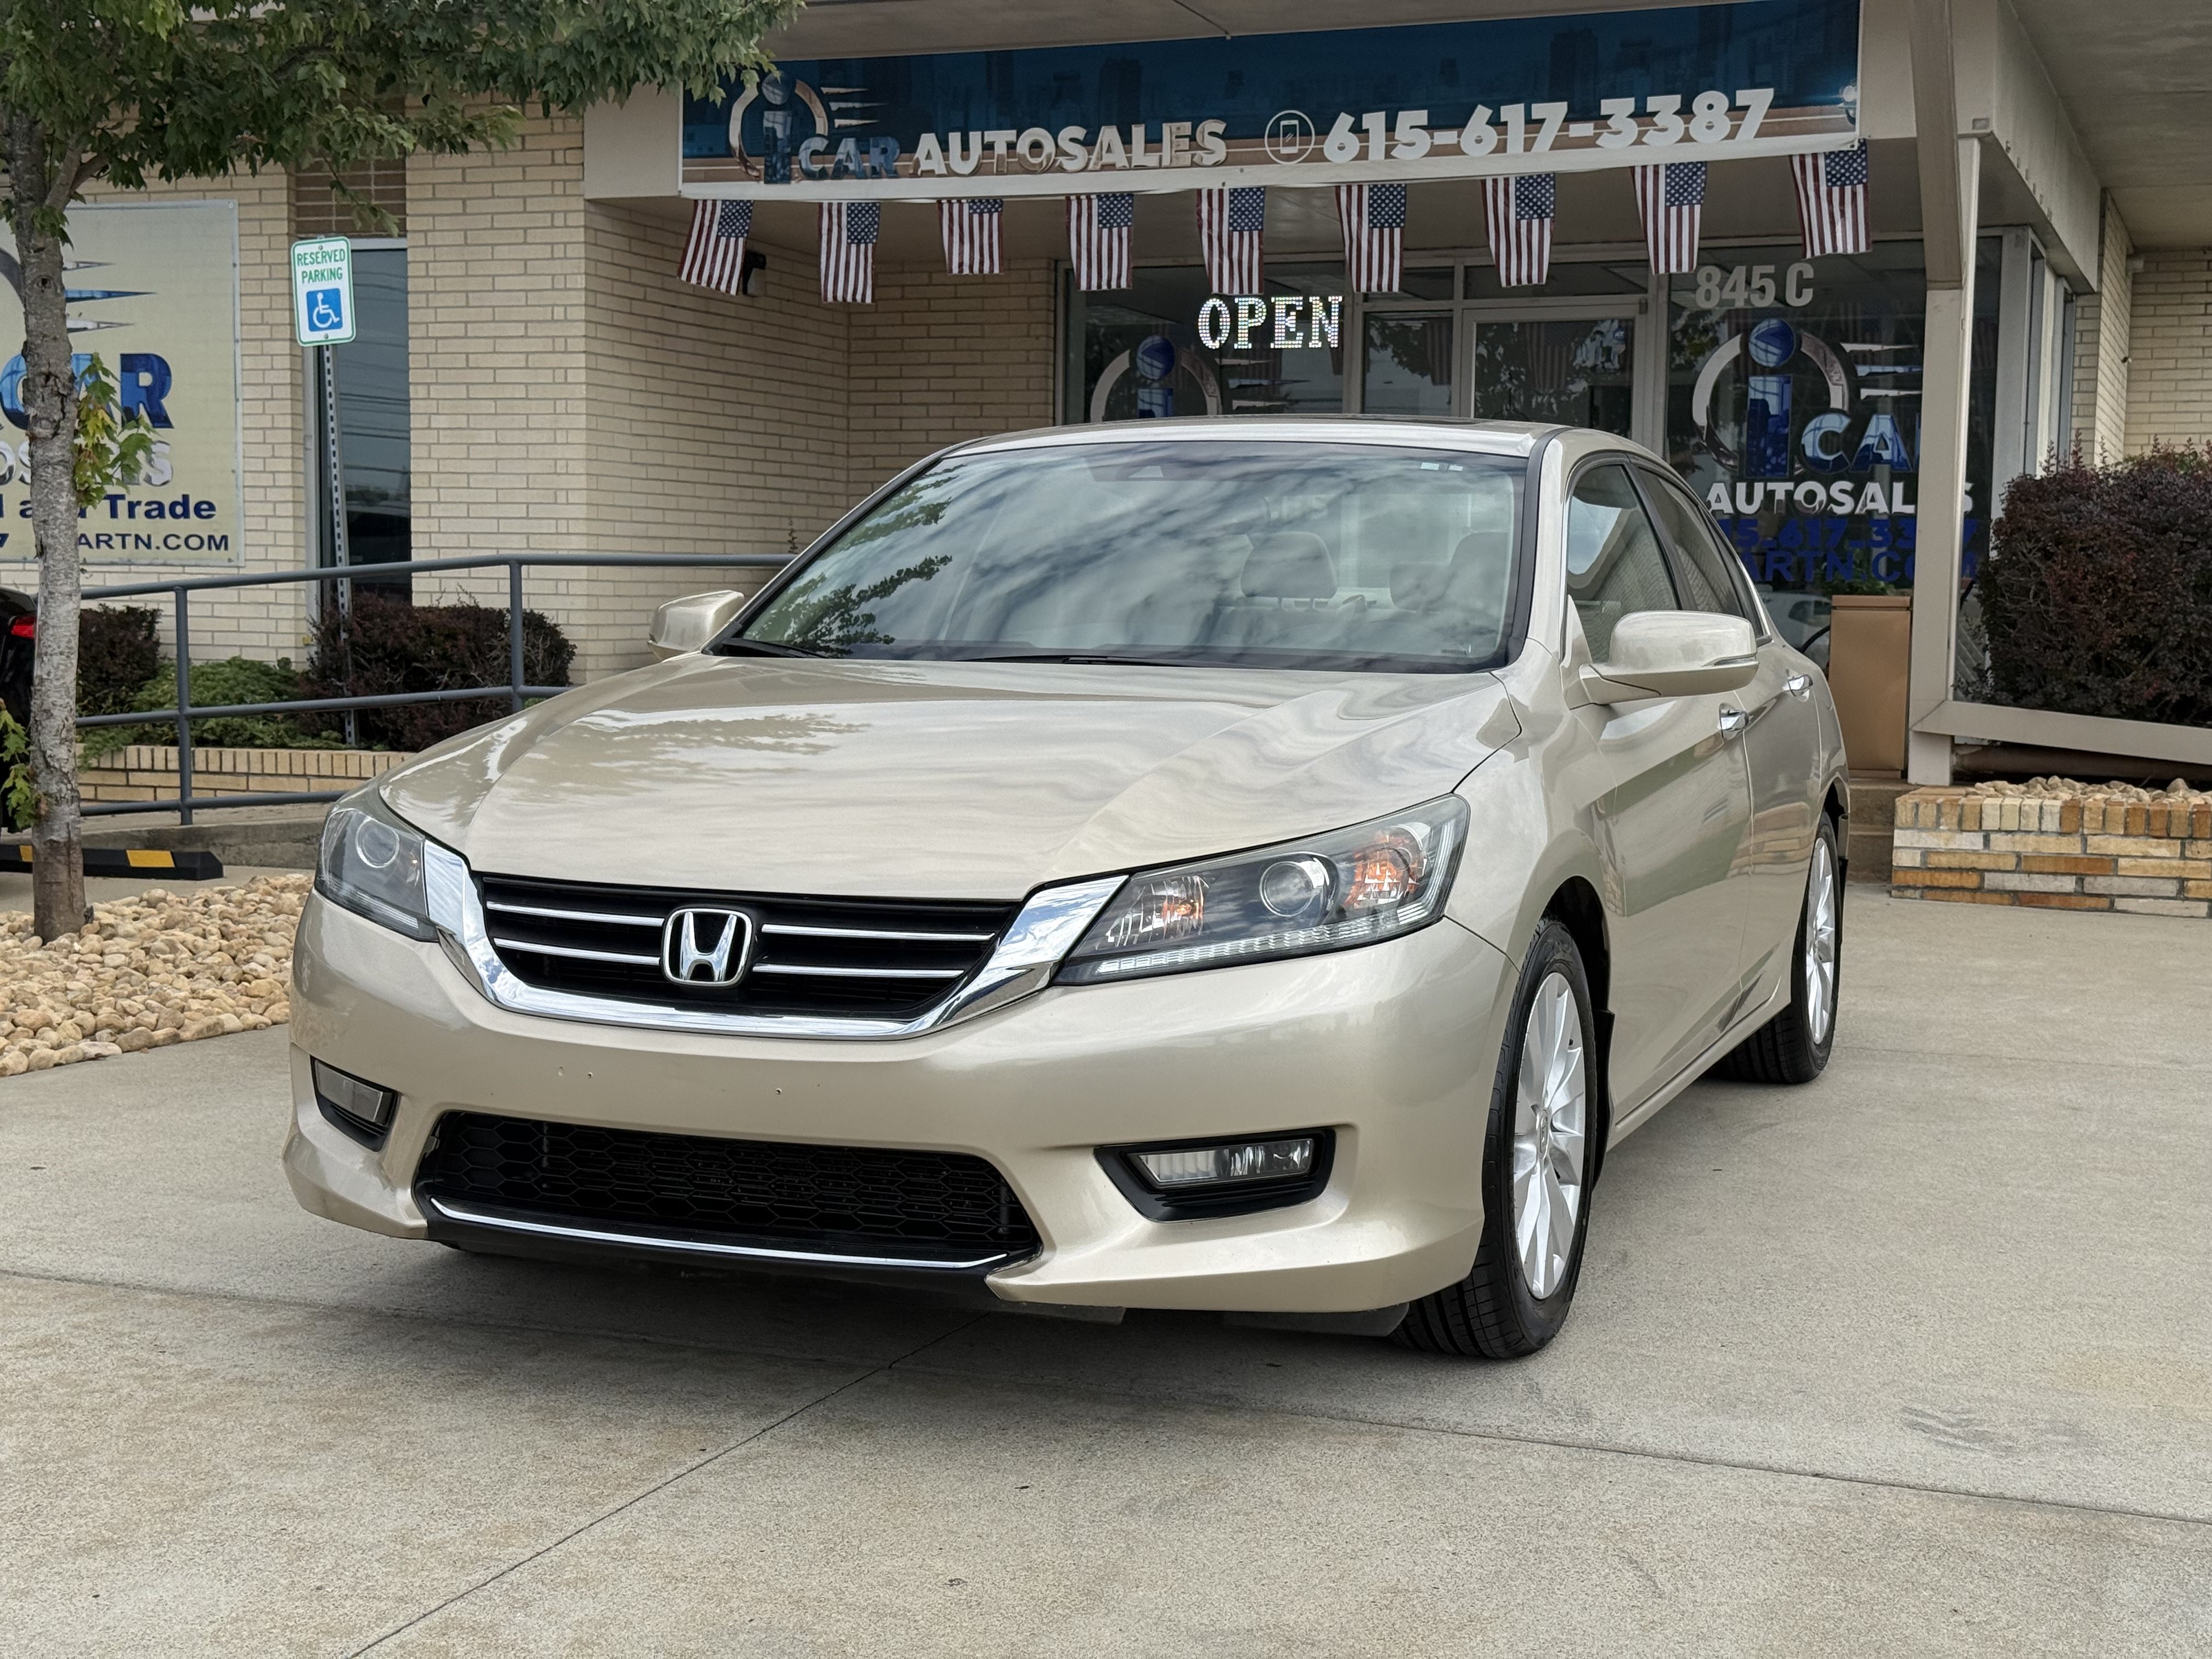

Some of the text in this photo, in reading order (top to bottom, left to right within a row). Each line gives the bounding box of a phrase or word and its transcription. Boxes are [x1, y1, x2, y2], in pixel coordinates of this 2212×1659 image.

[909, 119, 1227, 177] AUTOSALES
[1323, 88, 1775, 163] 615-617-3387
[297, 249, 346, 266] RESERVED
[302, 267, 343, 284] PARKING
[1696, 263, 1814, 308] 845 C
[1198, 296, 1343, 349] OPEN
[104, 494, 217, 520] Trade
[1706, 481, 1974, 515] AUTOSAL
[78, 534, 229, 551] ARTN.COM
